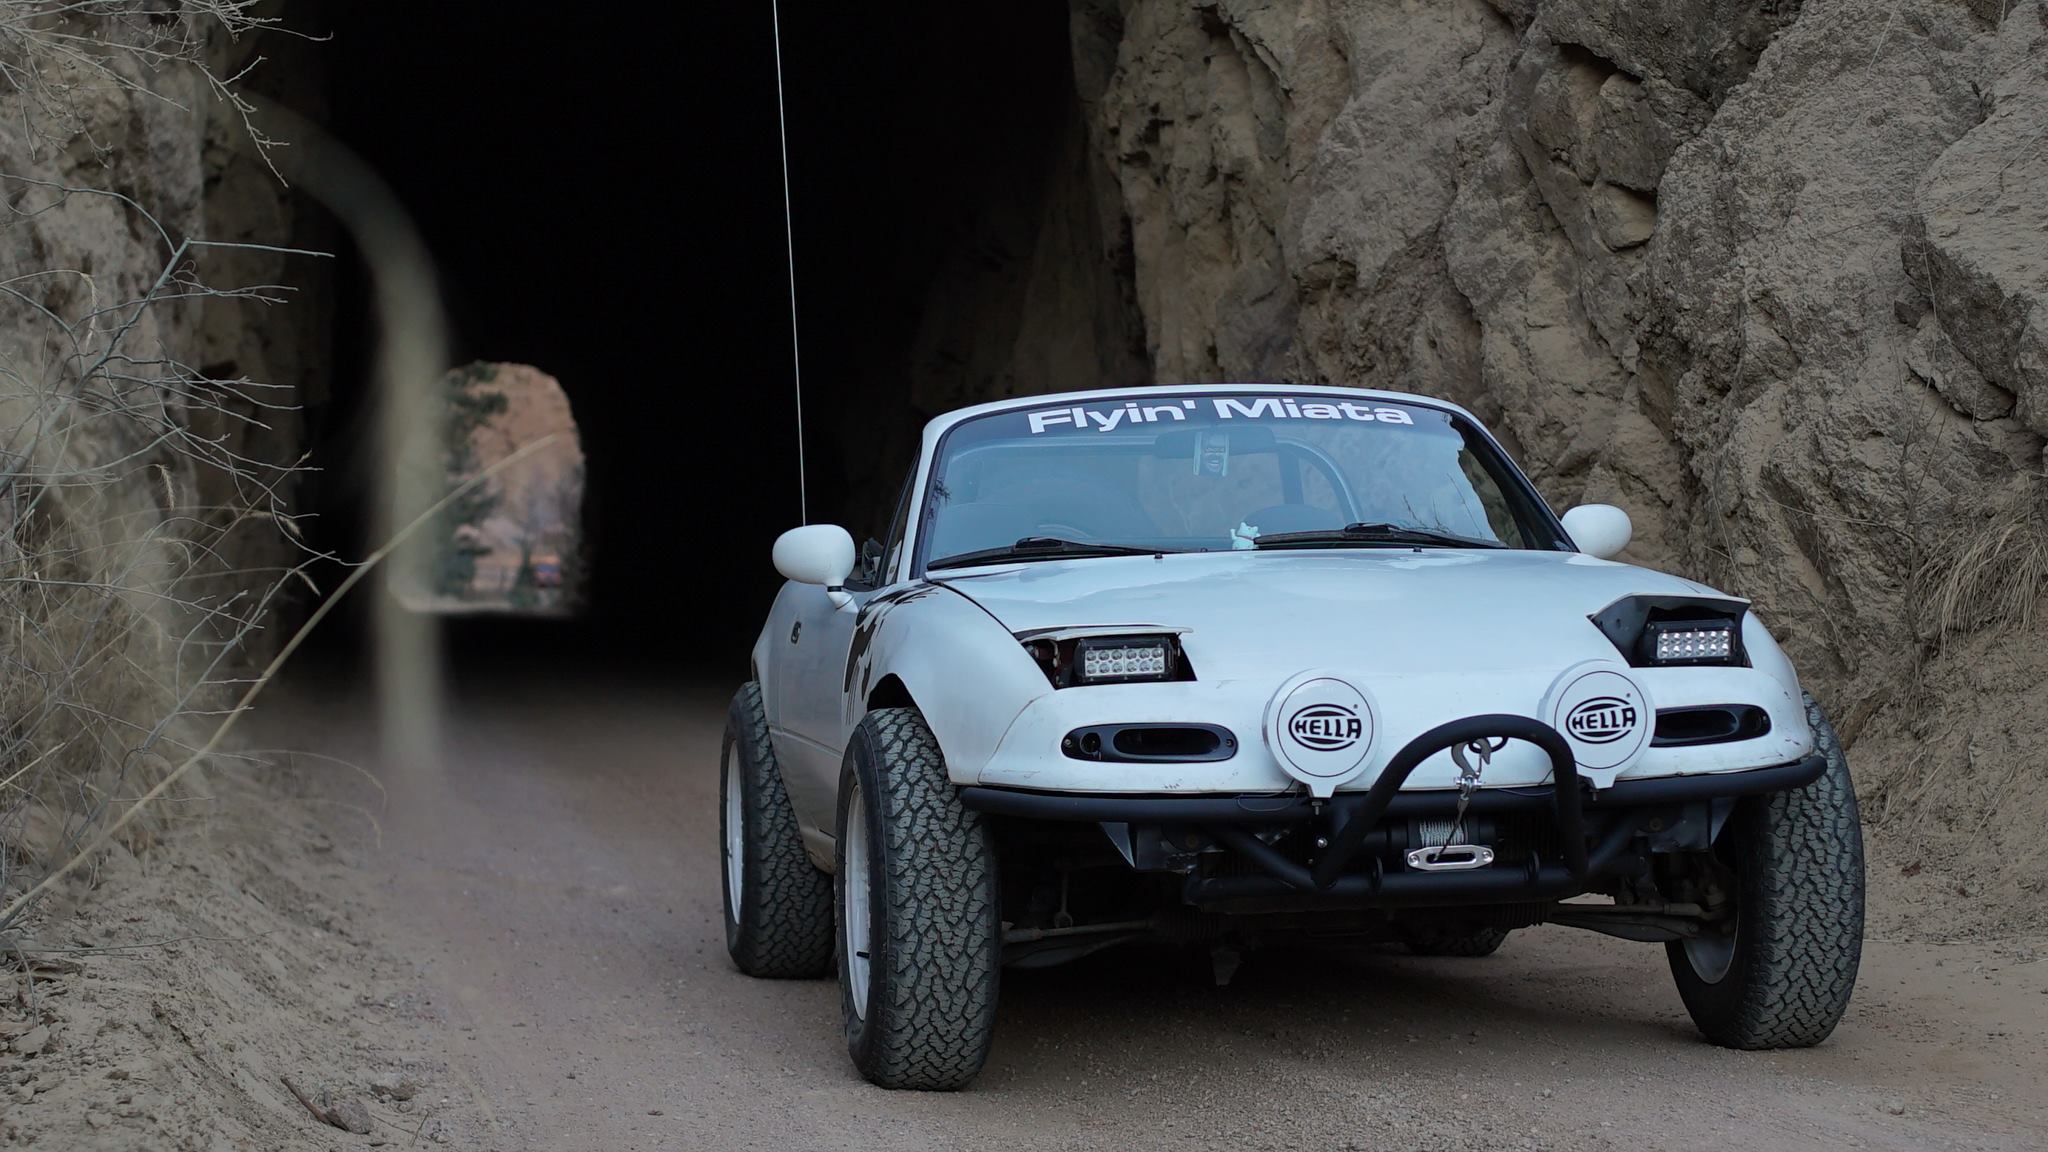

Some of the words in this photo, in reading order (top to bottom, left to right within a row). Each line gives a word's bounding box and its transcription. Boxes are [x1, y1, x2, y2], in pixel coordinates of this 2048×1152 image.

[1027, 399, 1198, 434] Flyin'
[1211, 398, 1415, 426] Miata
[1294, 718, 1362, 739] HELLA
[1571, 706, 1637, 730] HELLA
